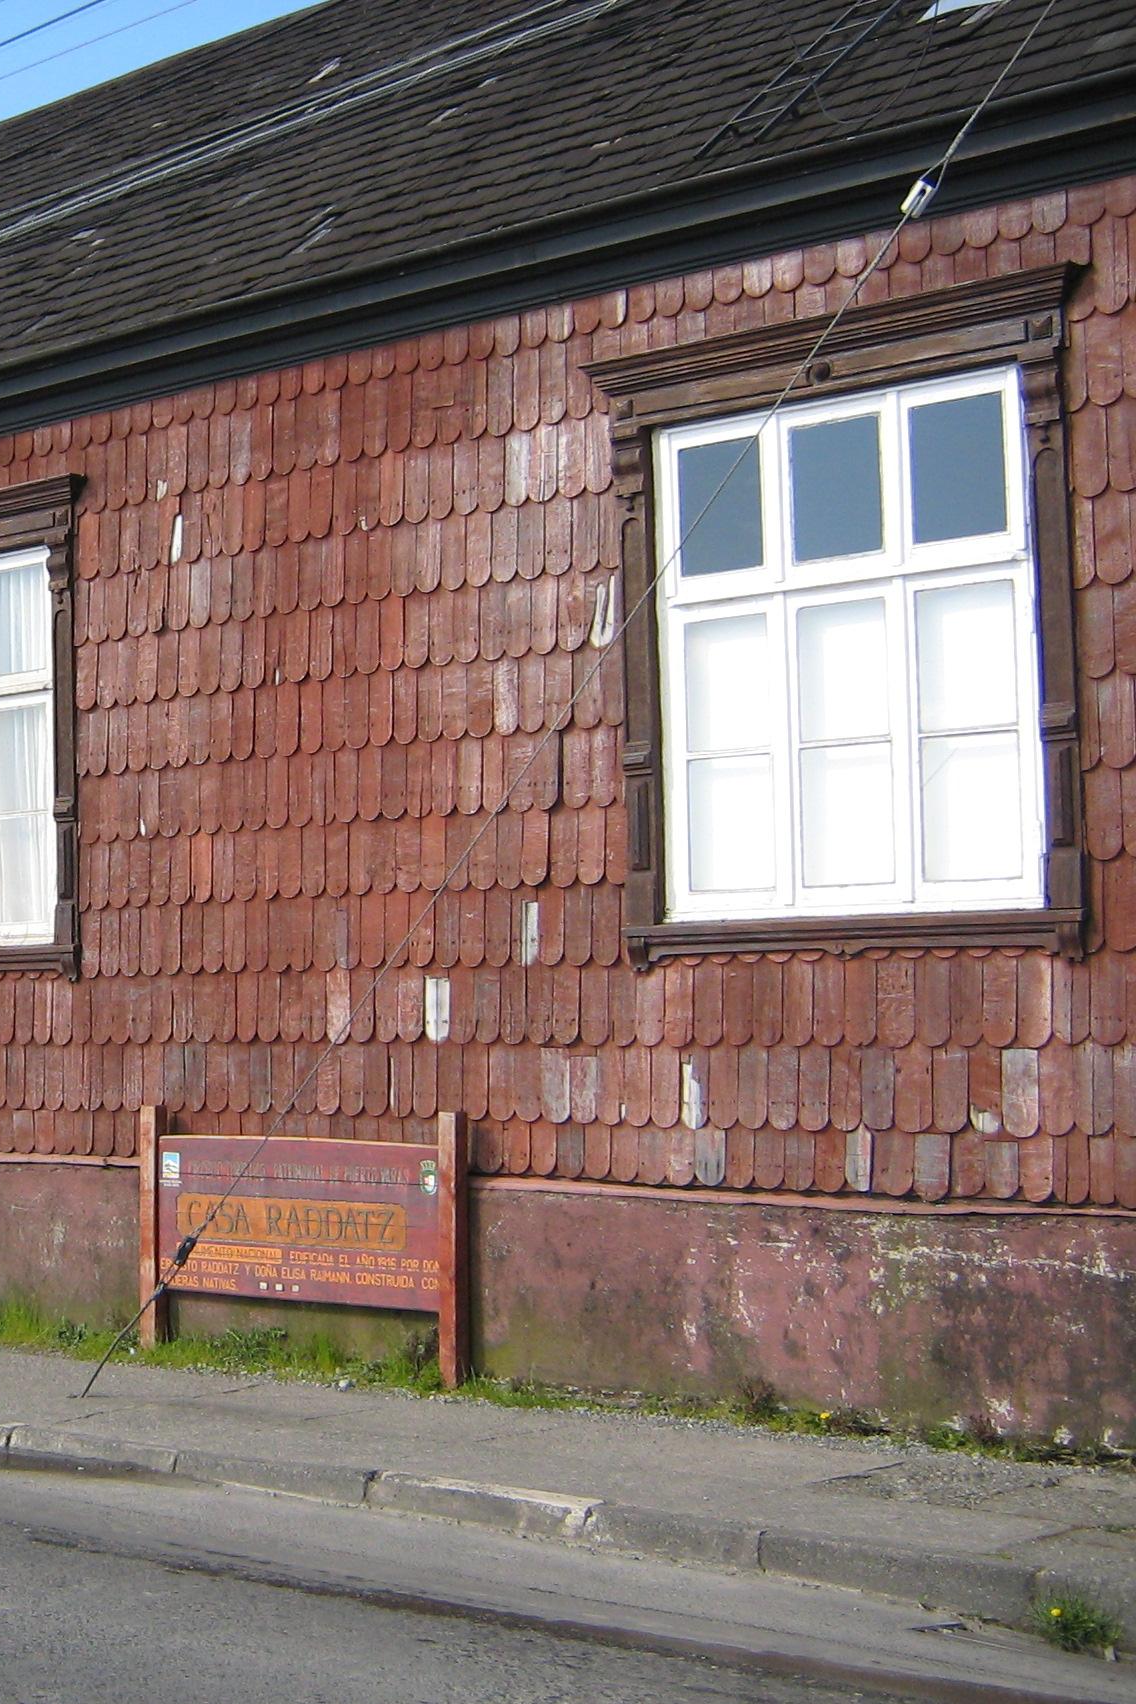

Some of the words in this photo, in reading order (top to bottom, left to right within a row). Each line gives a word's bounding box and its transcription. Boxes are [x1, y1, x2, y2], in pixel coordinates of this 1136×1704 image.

[187, 1200, 250, 1235] CASA
[267, 1204, 394, 1244] RADDATZ
[289, 1250, 335, 1265] EDIFICADA
[338, 1255, 351, 1268] EL
[355, 1254, 375, 1269] AÑO
[400, 1259, 419, 1272] POR
[201, 1263, 238, 1275] RADDATZ
[244, 1266, 251, 1276] Y
[254, 1266, 278, 1280] DOÑA
[281, 1268, 306, 1281] ELISA
[355, 1272, 415, 1290] CONSTRUIDA
